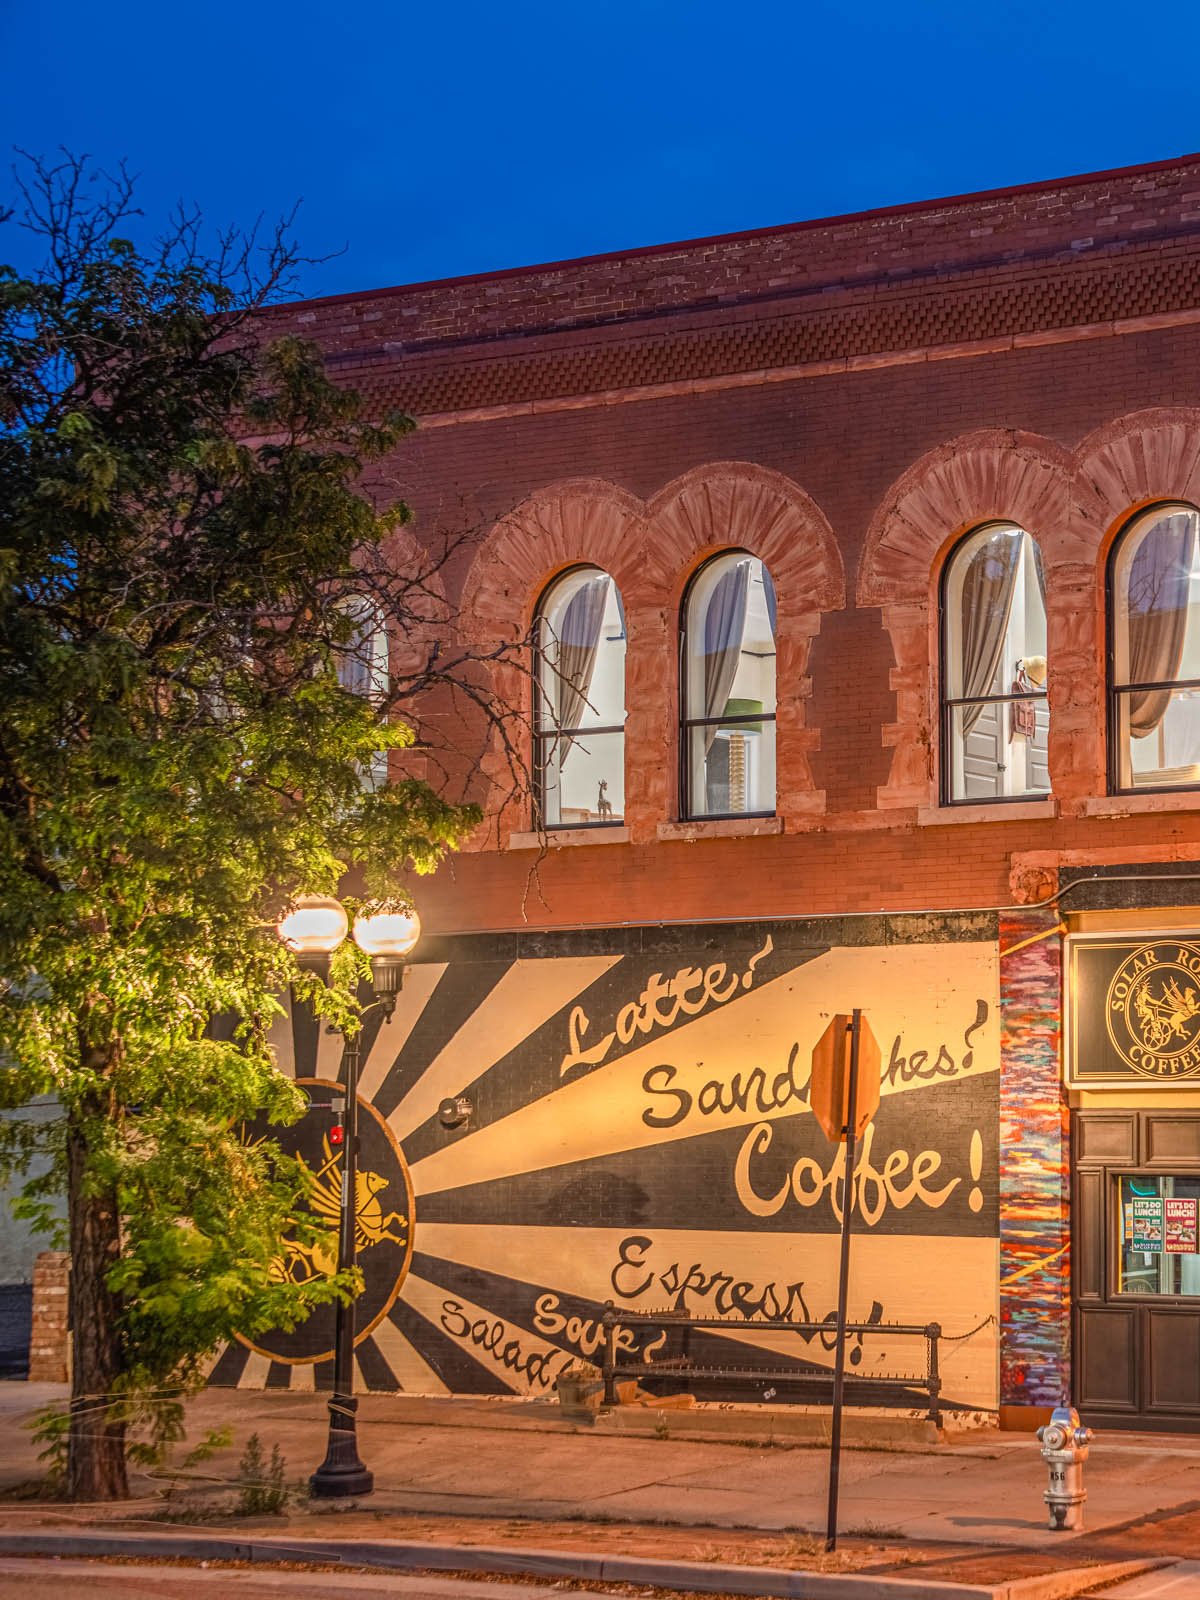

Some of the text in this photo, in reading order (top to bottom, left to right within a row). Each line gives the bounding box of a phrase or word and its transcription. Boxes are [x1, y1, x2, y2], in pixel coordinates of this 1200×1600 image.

[1111, 949, 1159, 1012] SOLAR
[642, 999, 989, 1129] Sandhes!
[735, 1121, 984, 1227] Coffee!
[1134, 1201, 1149, 1209] LET'S
[1167, 1209, 1195, 1217] LUNCH!
